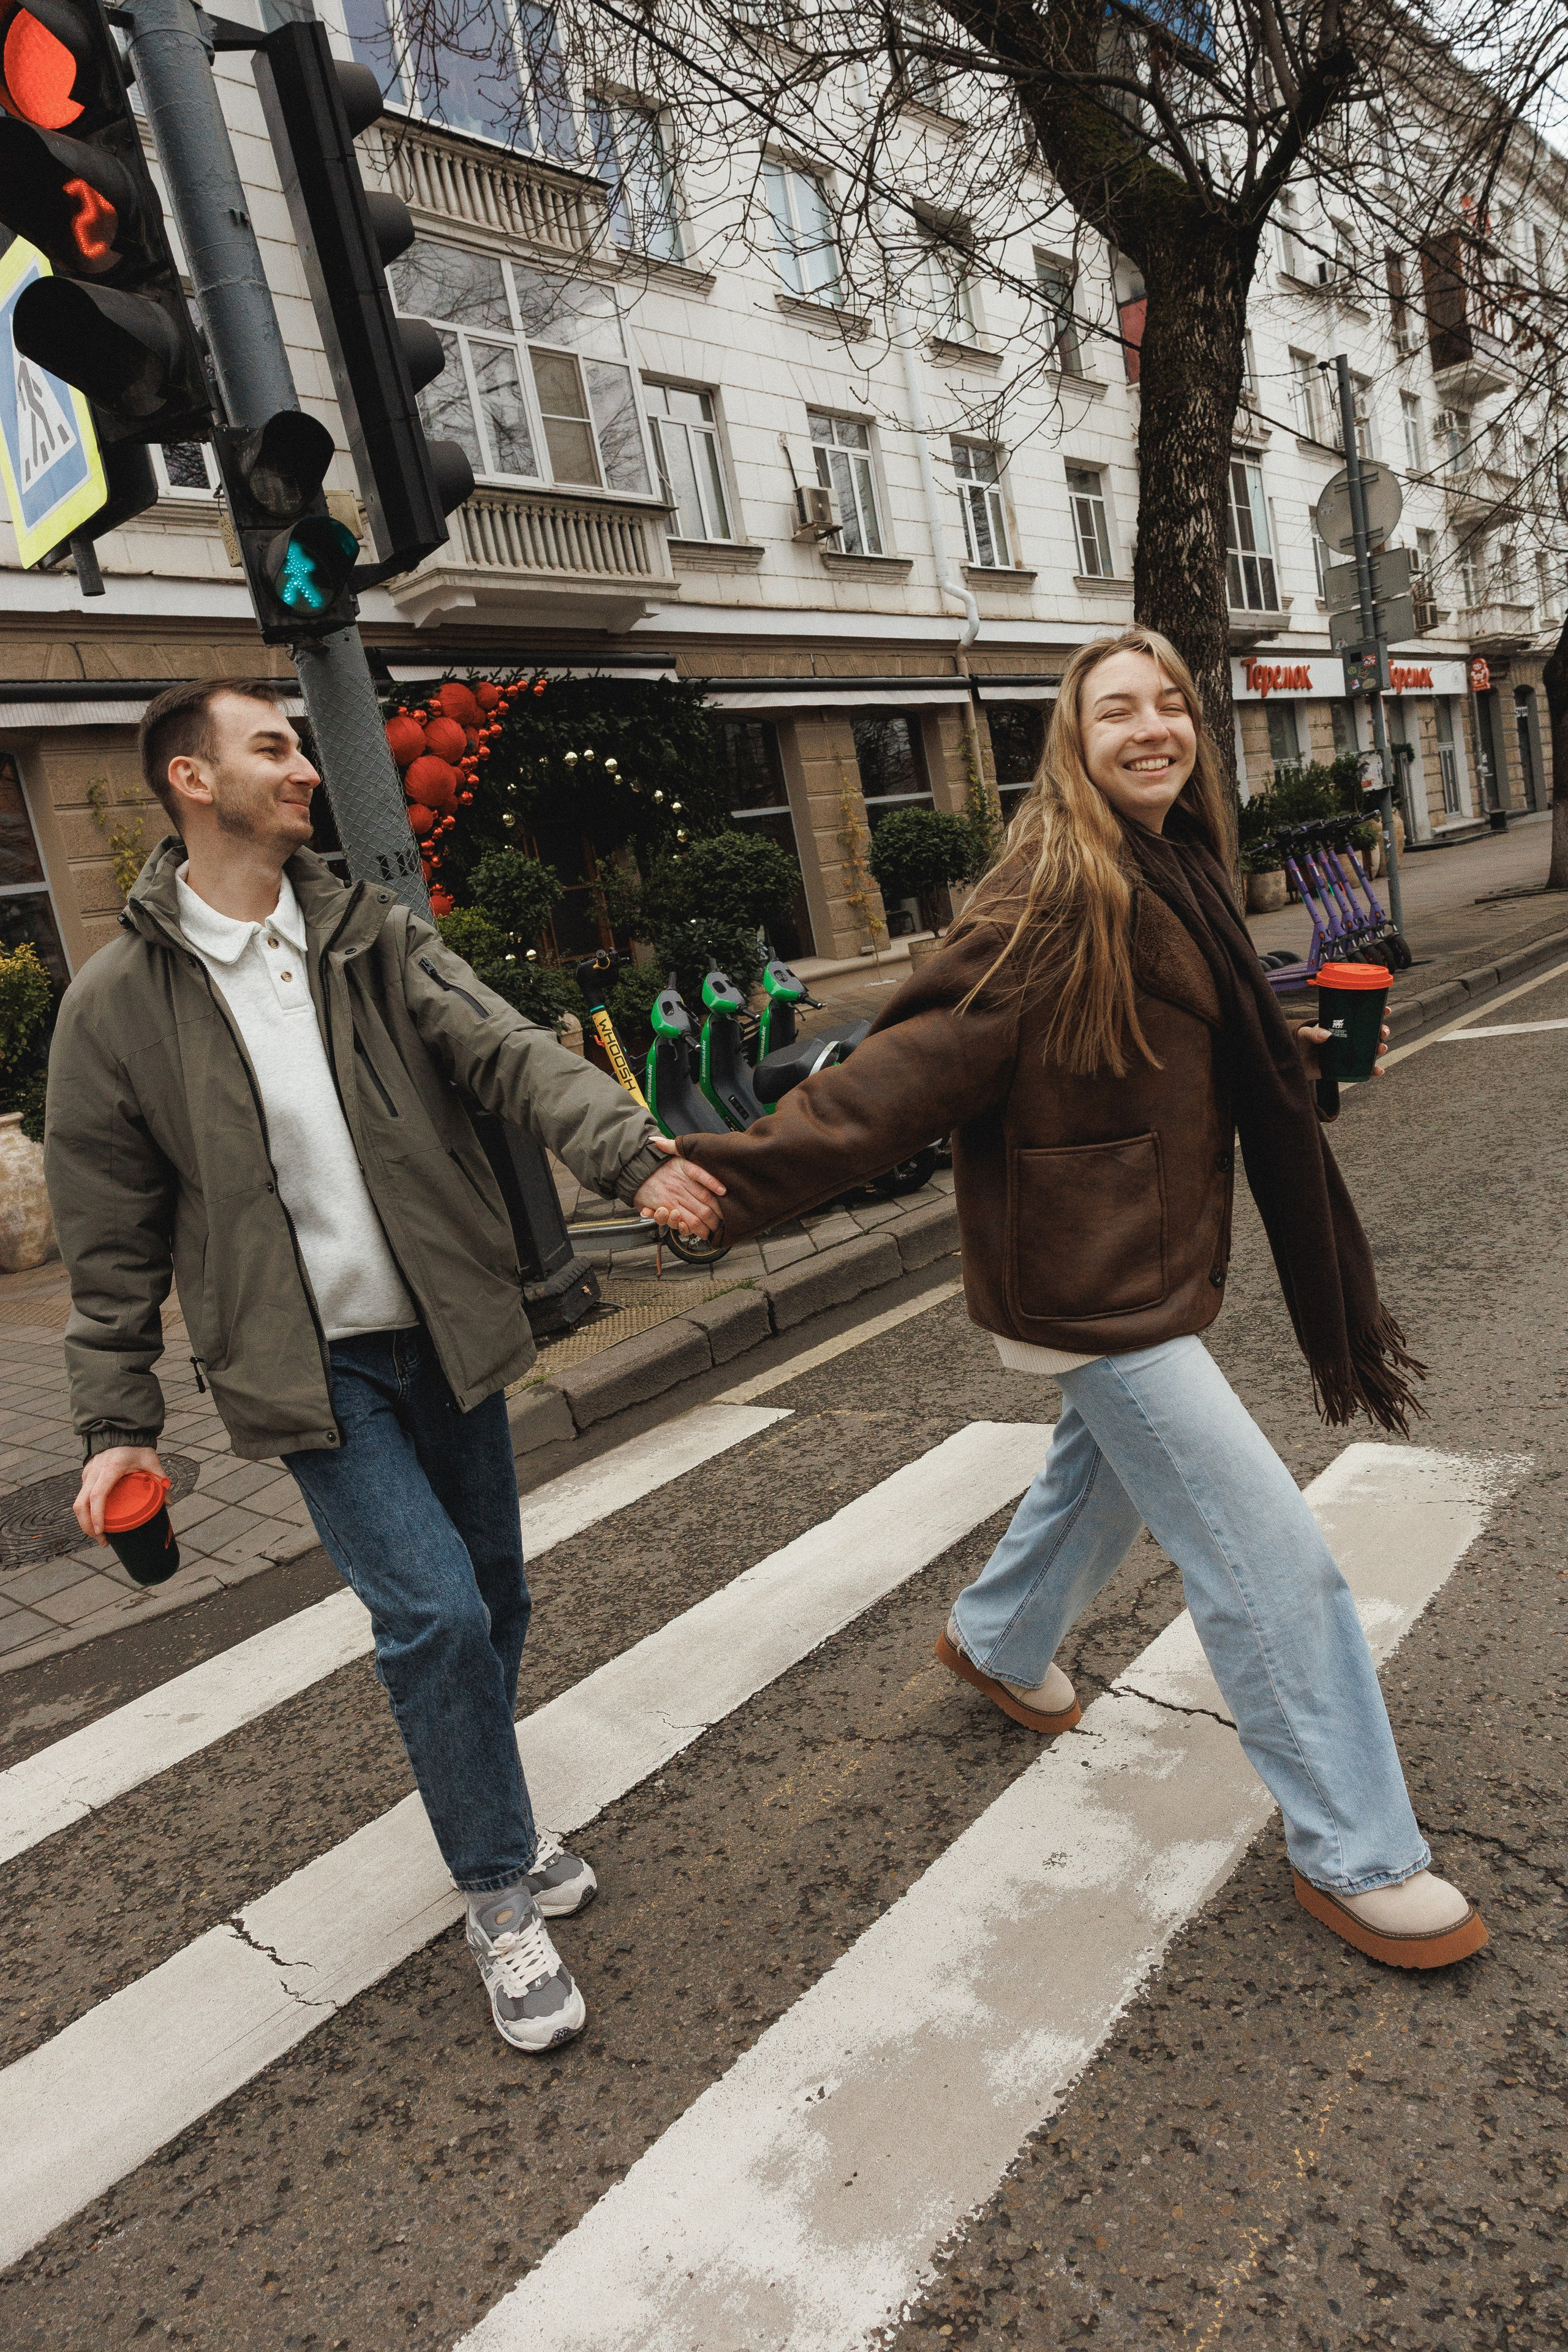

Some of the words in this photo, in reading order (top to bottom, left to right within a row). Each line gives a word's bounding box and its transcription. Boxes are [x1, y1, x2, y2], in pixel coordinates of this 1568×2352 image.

[1240, 657, 1313, 698] Теремок
[599, 1018, 636, 1091] WHOOSH
[535, 1978, 541, 1987] N
